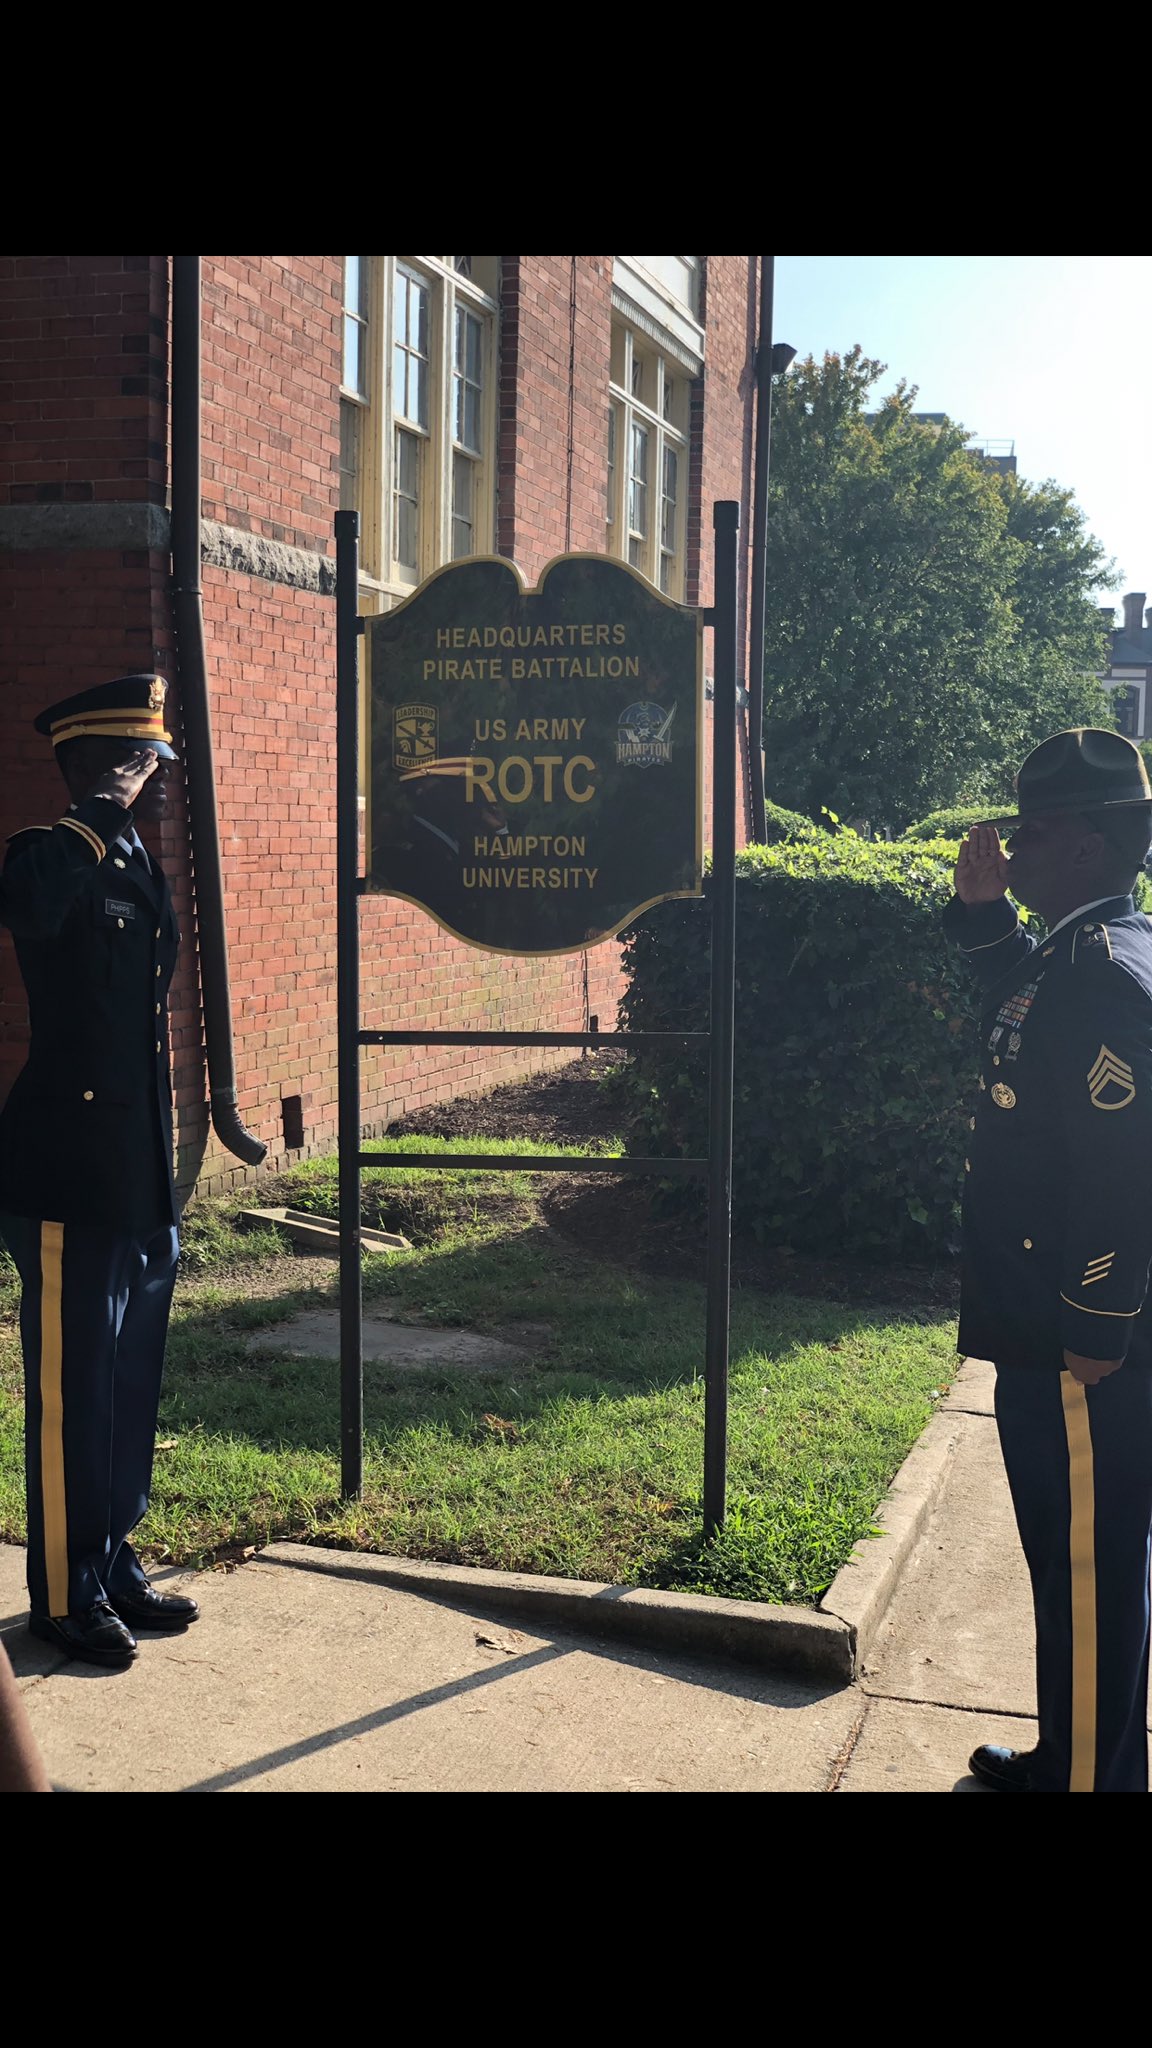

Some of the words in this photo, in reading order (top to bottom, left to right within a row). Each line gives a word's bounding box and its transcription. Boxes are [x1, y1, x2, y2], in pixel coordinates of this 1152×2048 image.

[437, 624, 627, 649] HEADQUARTERS
[423, 659, 503, 681] PIRATE
[511, 656, 640, 680] BATTALION
[397, 707, 434, 718] LEADERSHIP
[474, 719, 507, 742] US
[516, 718, 587, 741] ARMY
[618, 743, 670, 759] HAMPTON
[465, 755, 597, 804] ROTC
[474, 836, 586, 857] HAMPTON
[462, 867, 599, 889] UNIVERSITY
